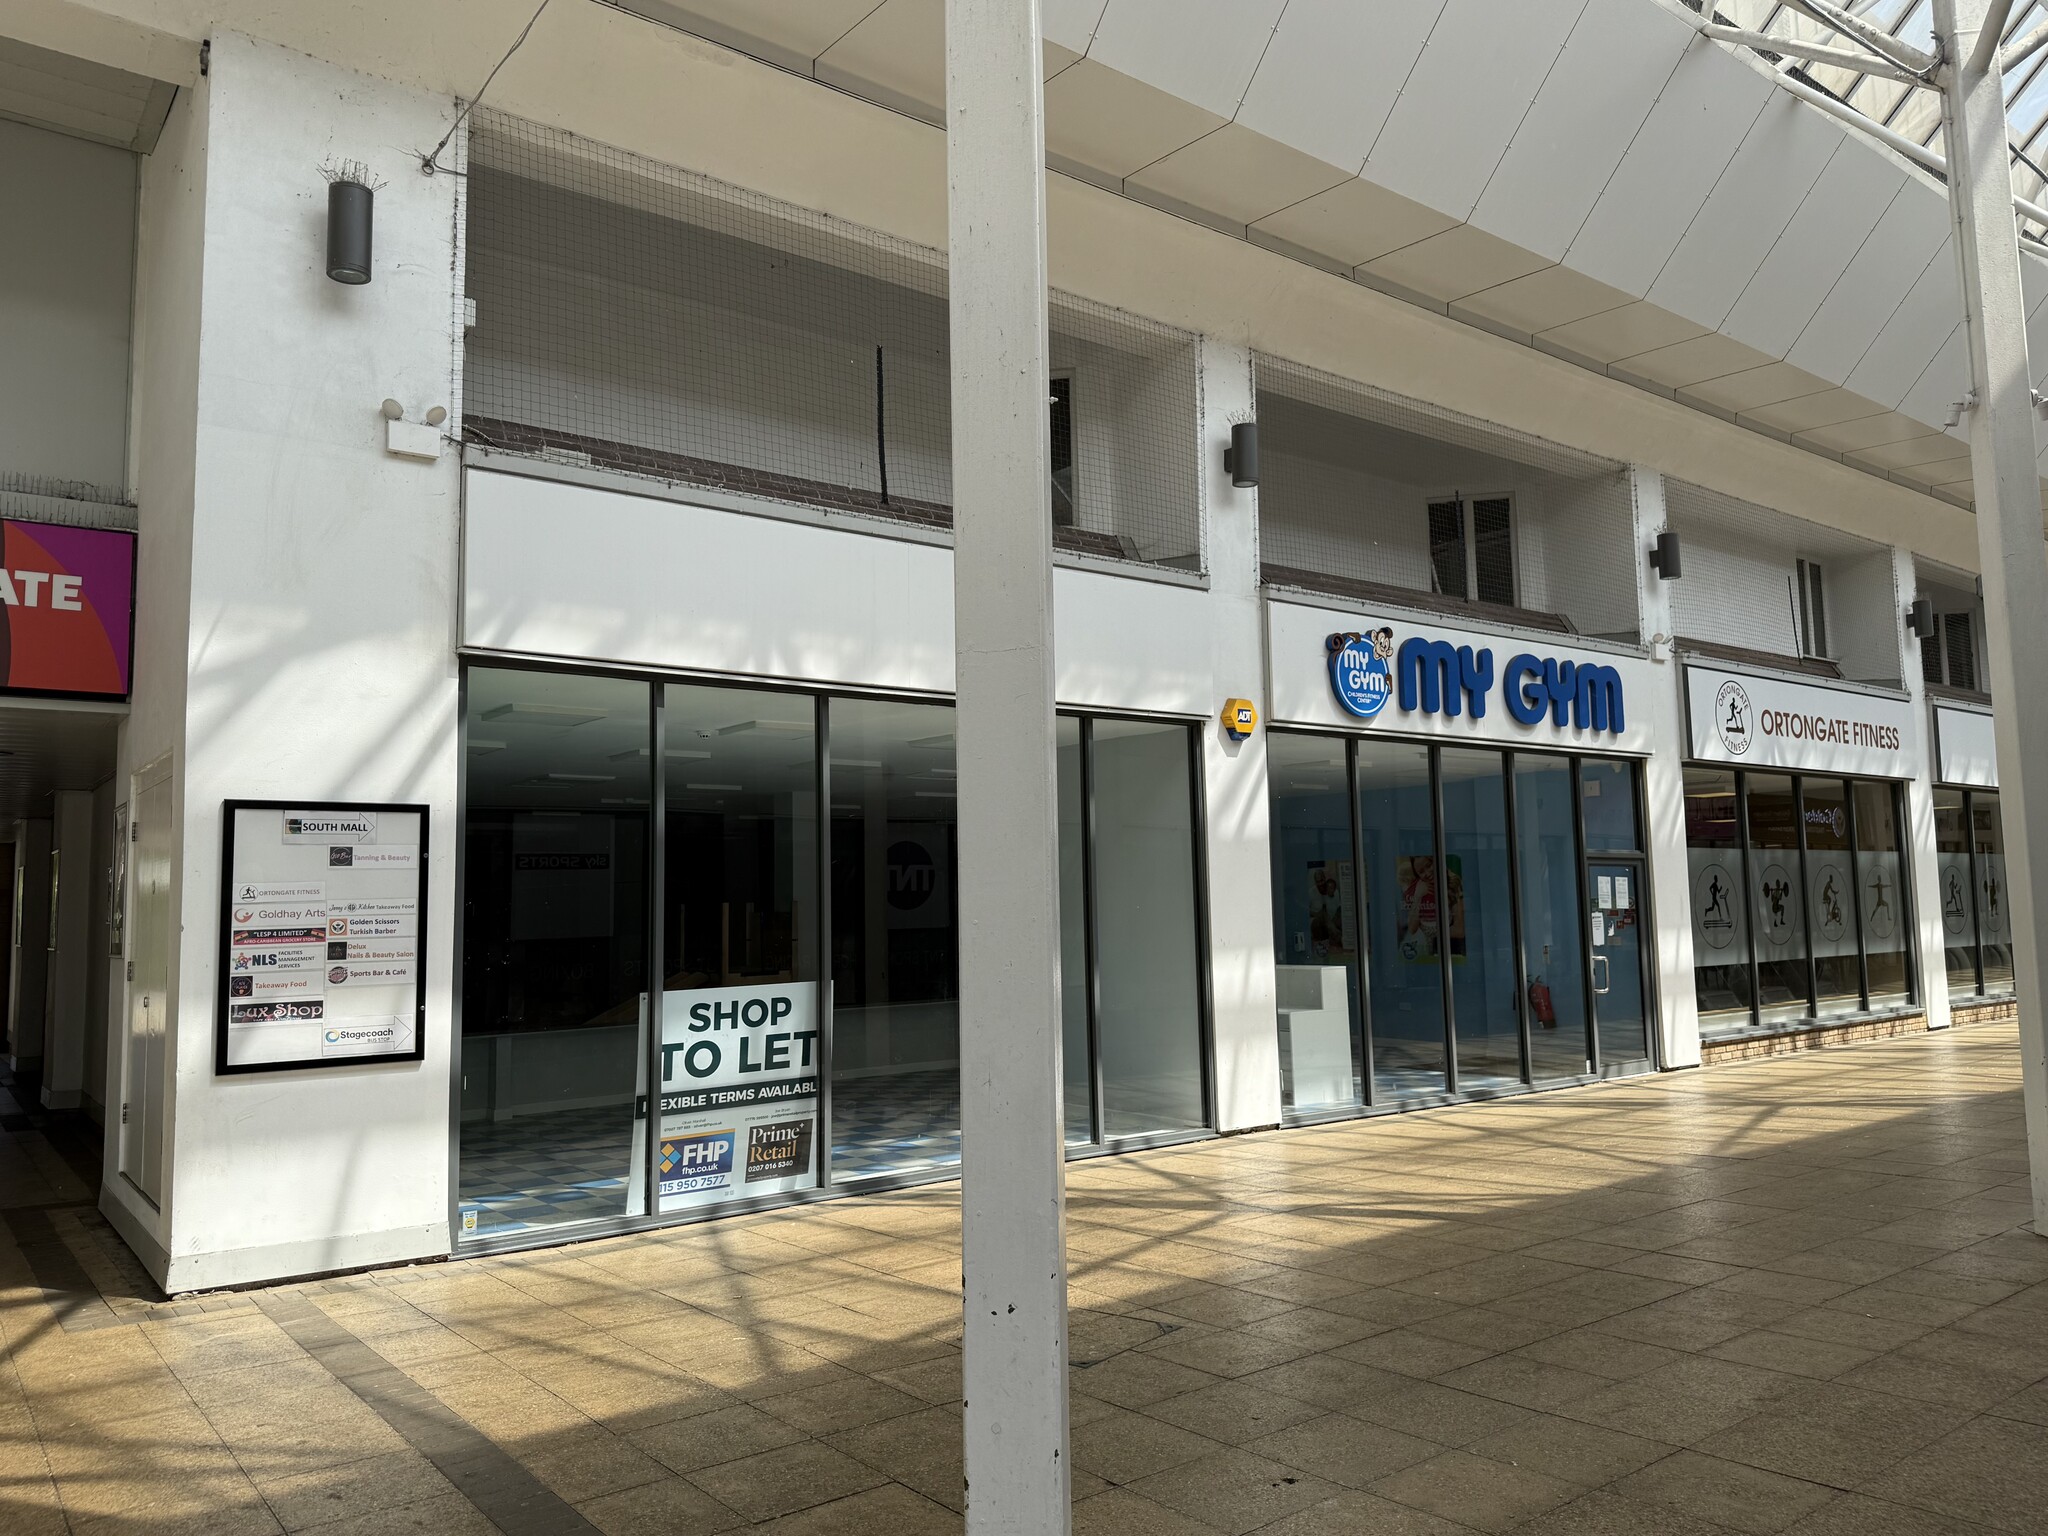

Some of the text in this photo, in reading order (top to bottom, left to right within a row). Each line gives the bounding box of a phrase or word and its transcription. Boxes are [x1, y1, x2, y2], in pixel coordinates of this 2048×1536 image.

[1344, 649, 1384, 692] MY GYM
[1398, 637, 1625, 734] MY GYM
[1718, 683, 1750, 711] ORTONGATE
[1237, 710, 1252, 722] ADT
[1761, 709, 1900, 750] ORTONGATE FITNESS
[1724, 735, 1748, 753] FITNESS
[303, 823, 368, 832] SOUTH MALL
[354, 854, 379, 862] Tanning
[388, 854, 410, 862] Beauty
[258, 909, 326, 920] Goldhay Arts
[251, 953, 277, 967] NLS
[350, 970, 371, 978] Sports
[255, 982, 288, 990] Takeaway
[232, 1005, 269, 1019] Lux
[273, 1003, 323, 1019] Shop
[687, 997, 792, 1032] SHOP
[340, 1028, 394, 1039] Stagecoach
[662, 1030, 817, 1082] TO LET
[710, 1089, 755, 1105] TERMS
[758, 1081, 817, 1098] AVAILABL
[751, 1126, 800, 1145] Prime
[682, 1140, 729, 1166] FHP
[750, 1140, 797, 1163] Retail
[682, 1162, 719, 1176] fhp.co.uk
[748, 1163, 764, 1173] 0207
[765, 1162, 776, 1171] 016
[677, 1178, 697, 1191] 950
[700, 1175, 726, 1187] 7577
